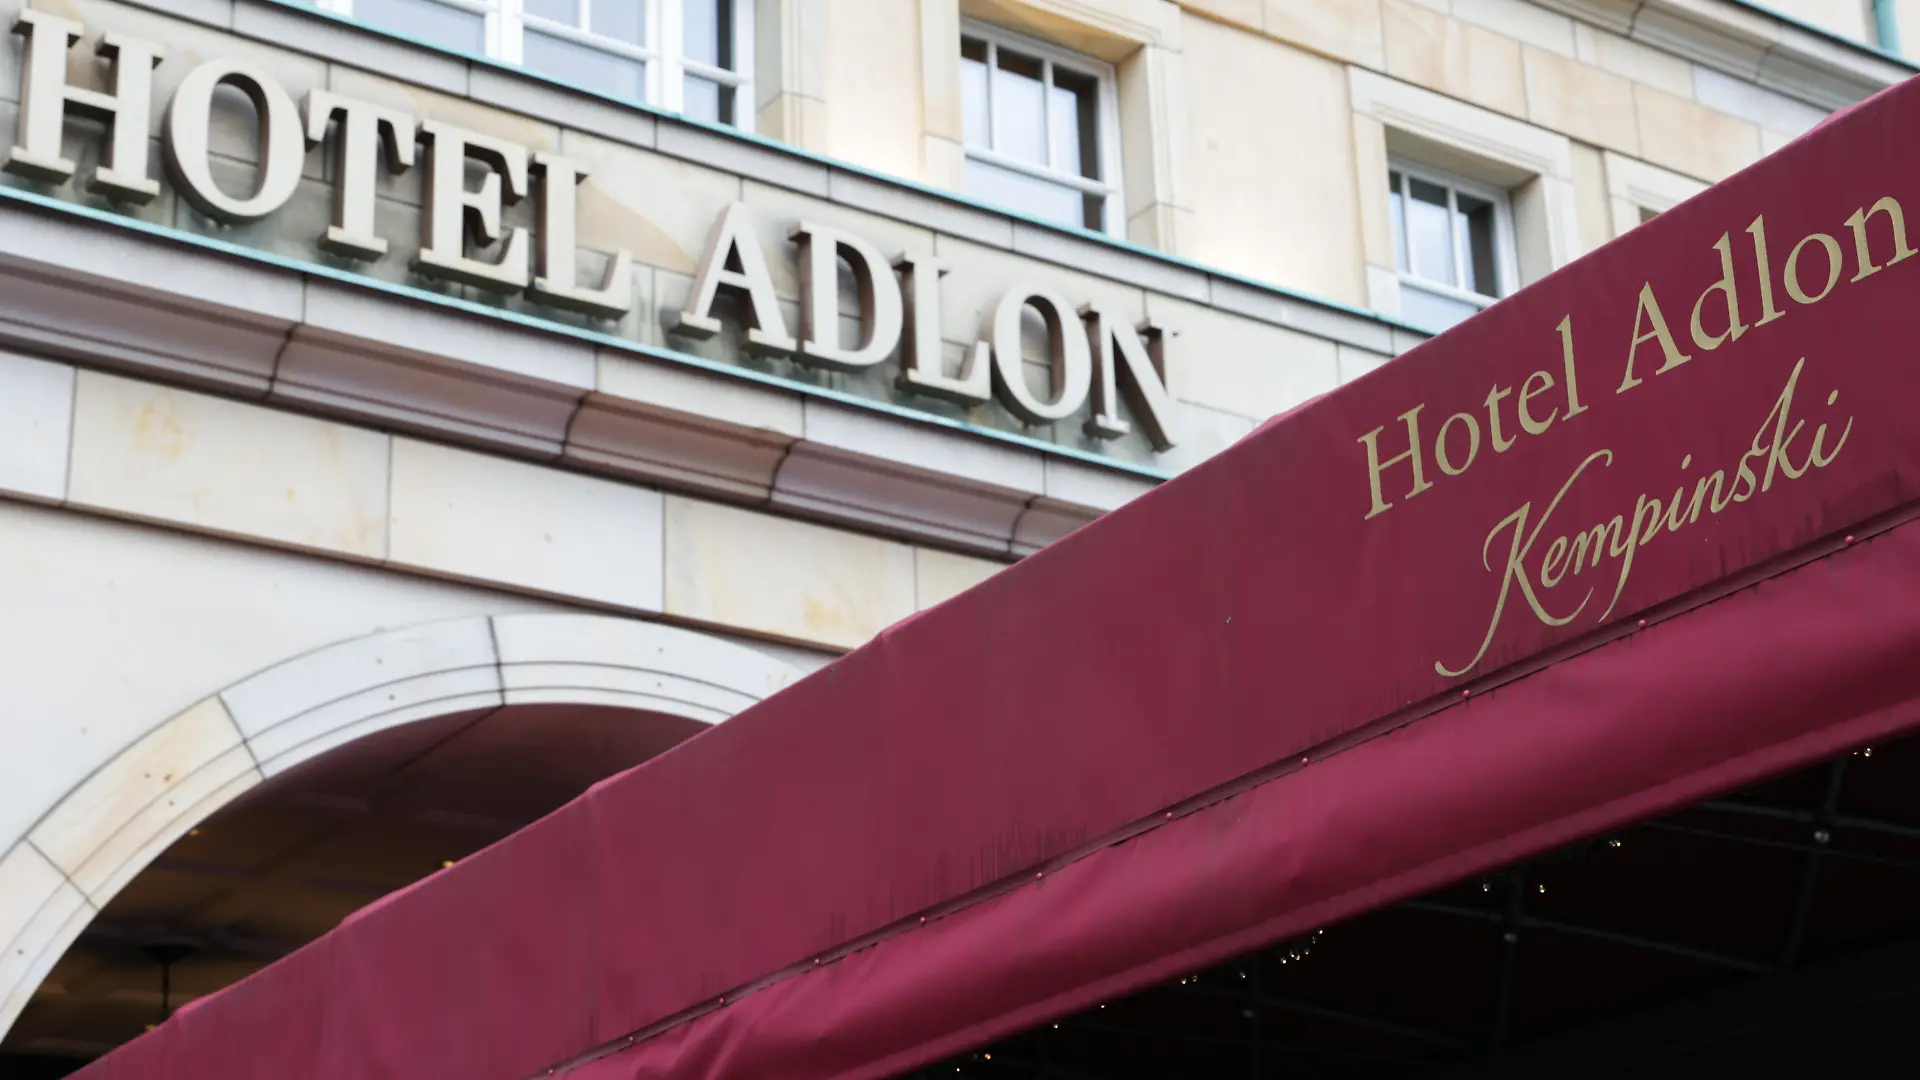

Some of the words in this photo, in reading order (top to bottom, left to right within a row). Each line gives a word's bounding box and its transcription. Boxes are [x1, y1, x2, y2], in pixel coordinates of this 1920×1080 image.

[4, 9, 633, 320] HOTEL
[669, 201, 1178, 453] ADLON
[1357, 314, 1588, 520] Hotel
[1616, 196, 1918, 394] Adlon
[1434, 356, 1853, 677] Kempinski
